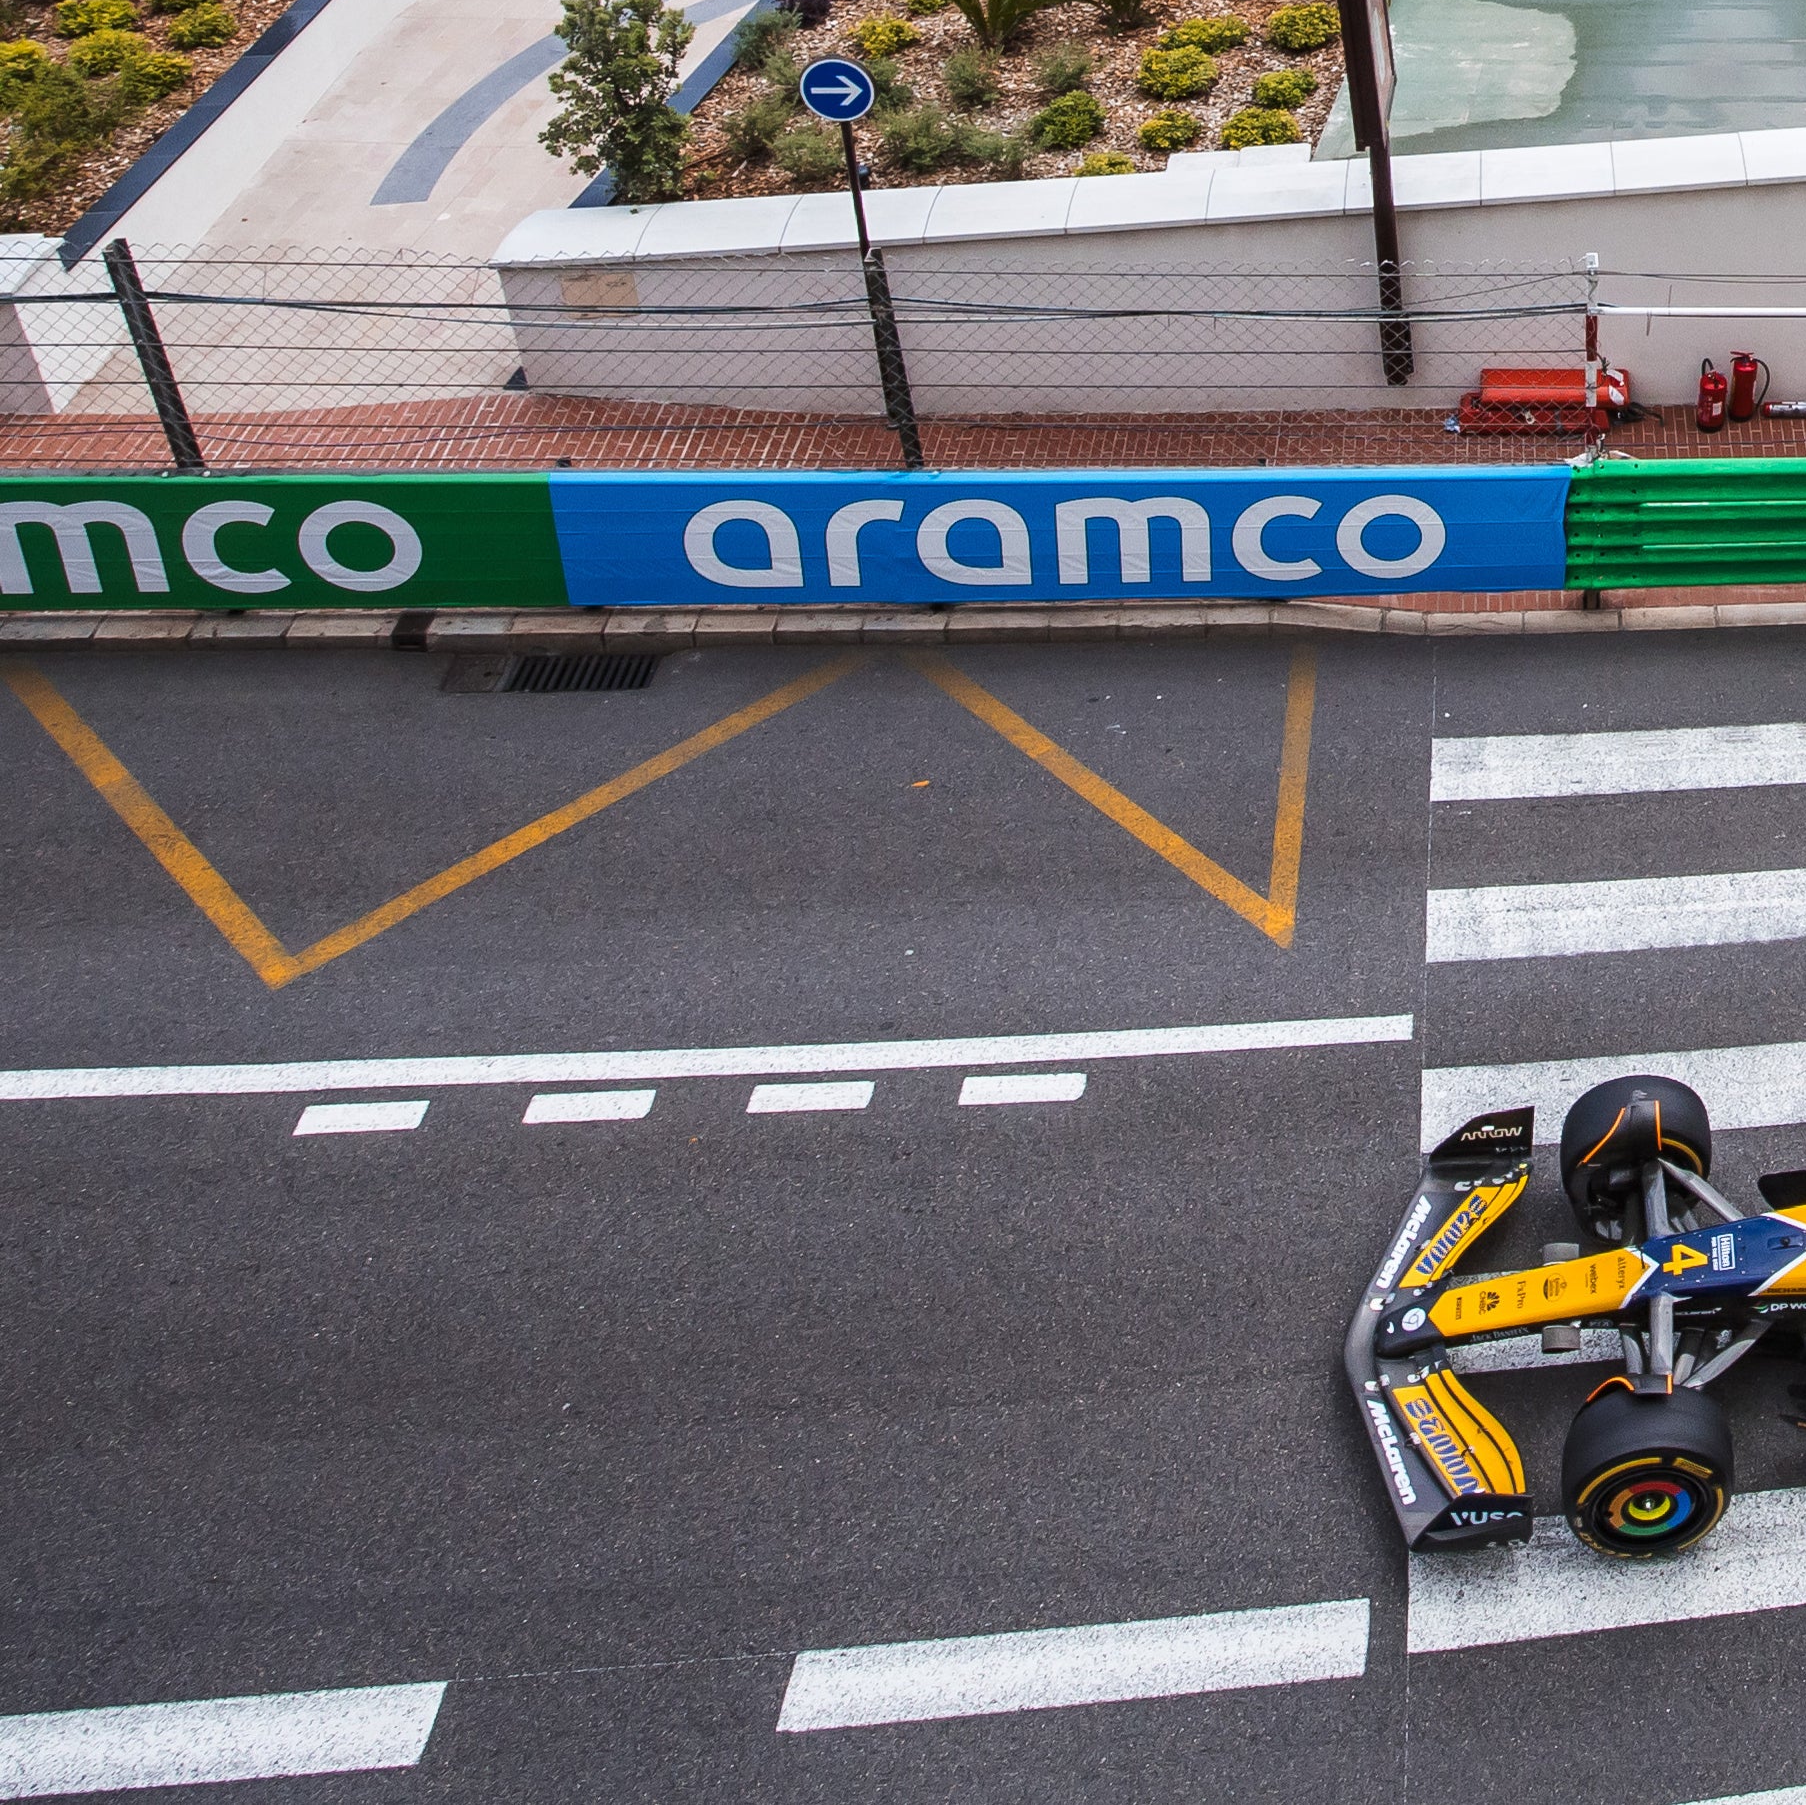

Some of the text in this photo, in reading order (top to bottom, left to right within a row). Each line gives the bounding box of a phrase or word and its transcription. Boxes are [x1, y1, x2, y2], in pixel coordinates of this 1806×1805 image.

[683, 494, 1446, 588] aramco
[1376, 1195, 1432, 1289] McLaren
[1720, 1237, 1731, 1267] Hilton
[1617, 1256, 1627, 1290] alteryx
[1662, 1244, 1708, 1276] 4
[1770, 1303, 1788, 1312] DP
[1366, 1399, 1417, 1506] McLaren
